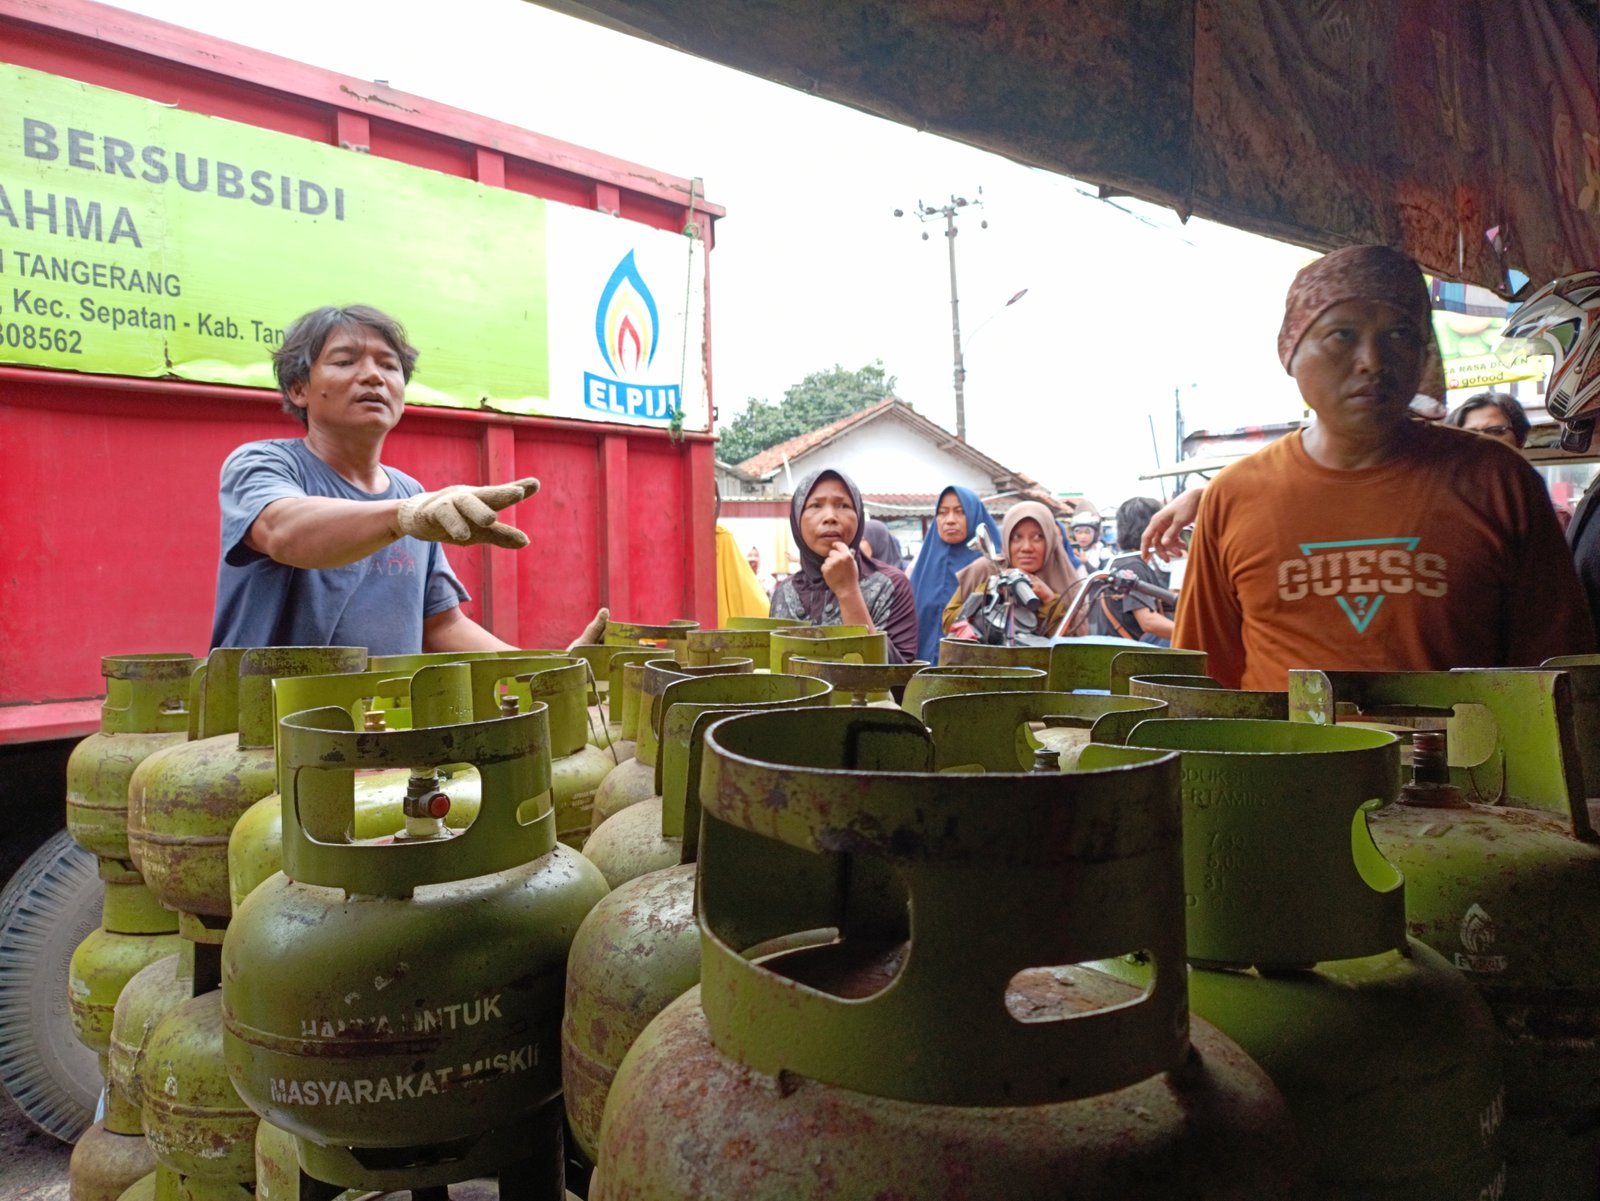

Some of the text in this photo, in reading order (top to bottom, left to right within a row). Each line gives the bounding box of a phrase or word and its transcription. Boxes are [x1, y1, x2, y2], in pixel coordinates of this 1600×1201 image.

[23, 117, 345, 221] BERSUBSIDI
[0, 184, 143, 249] AHMA
[13, 251, 182, 298] TANGERANG
[13, 288, 71, 319] Kec.
[79, 297, 177, 332] Sepatan
[198, 312, 244, 341] Kab.
[588, 378, 678, 418] ELPIJI
[1462, 371, 1504, 387] gofood
[1277, 550, 1447, 601] GUESS
[270, 1042, 540, 1106] MASYARAKAT MISKI
